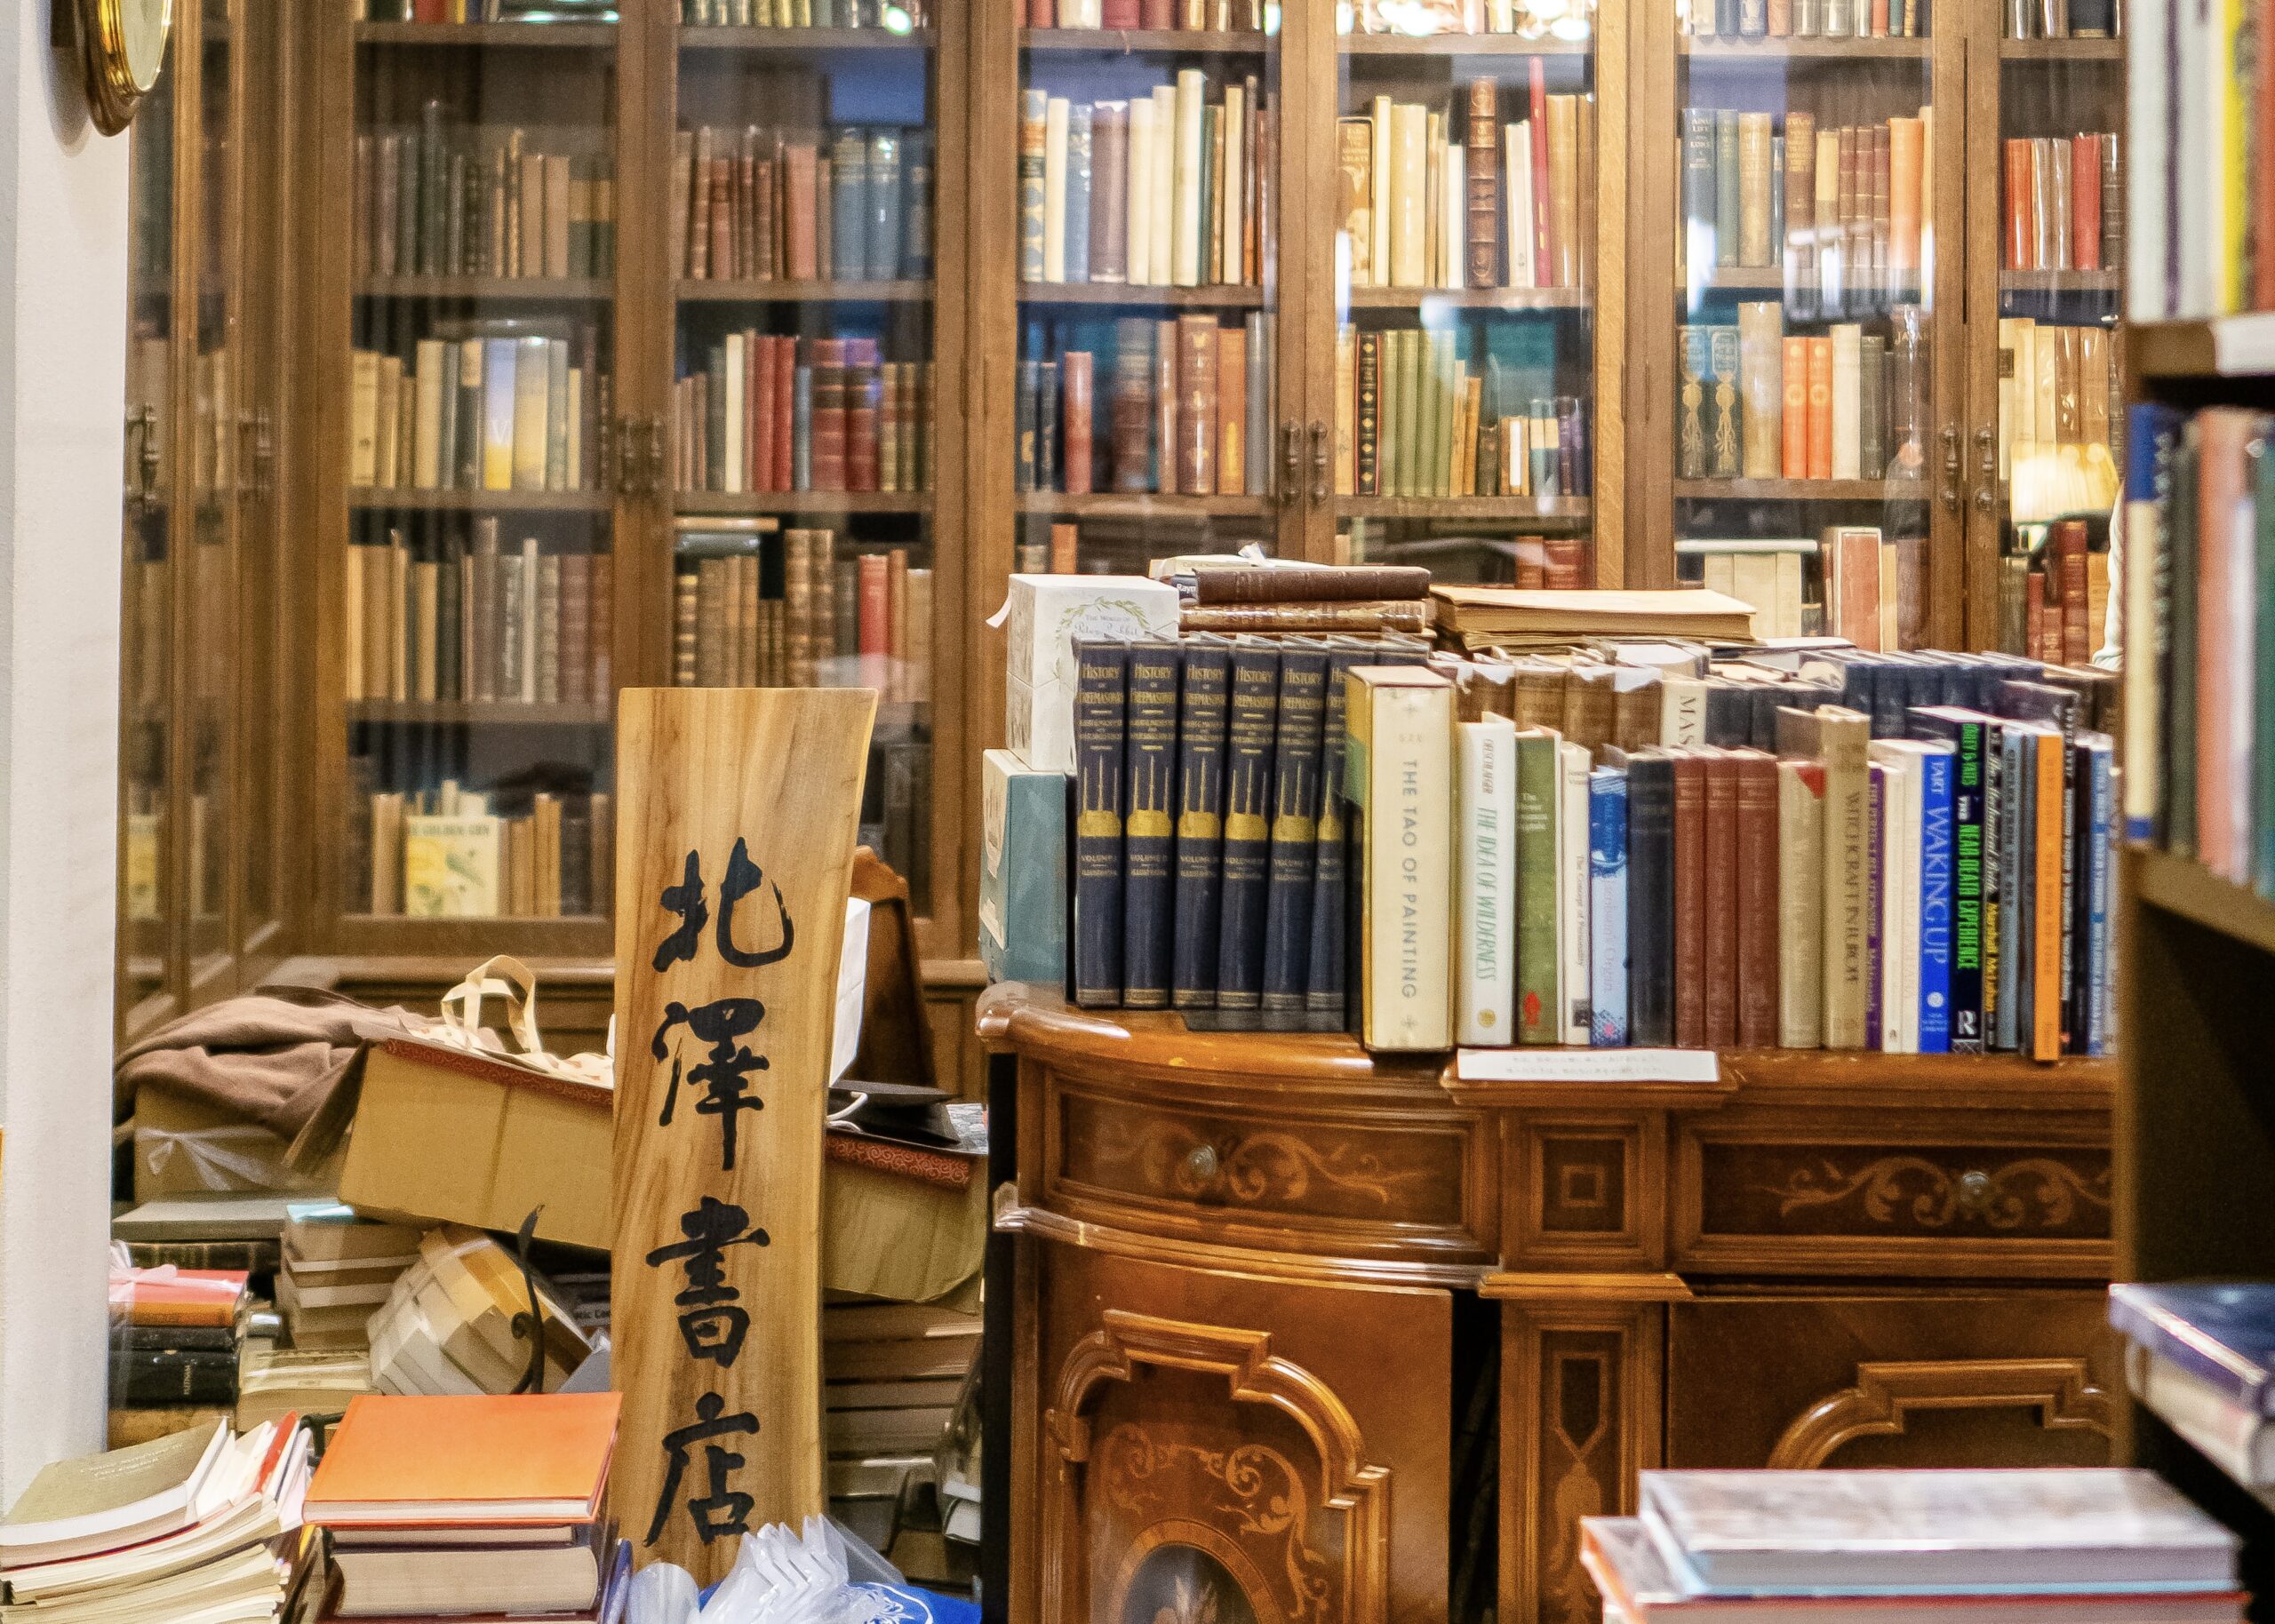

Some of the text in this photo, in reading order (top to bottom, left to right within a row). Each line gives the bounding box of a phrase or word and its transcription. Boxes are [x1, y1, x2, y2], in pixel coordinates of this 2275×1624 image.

[1082, 663, 1120, 680] HISTORY
[1135, 663, 1172, 680] HISTORY
[1187, 665, 1225, 681] HISTORY
[1236, 666, 1273, 683] HISTORY
[1284, 667, 1322, 685] HISTORY
[1929, 760, 1946, 796] TART
[1961, 761, 1978, 786] YATES
[1401, 760, 1418, 999] THE TAO OF PAINTING
[1475, 807, 1498, 982] THE IDEA OF WILDERNESS
[1574, 873, 1585, 908] Concept
[1922, 806, 1951, 965] WAKING UP
[1957, 795, 1980, 969] THE NEAR DEATH EXPERIENCE
[644, 836, 794, 1548] 北澤書店
